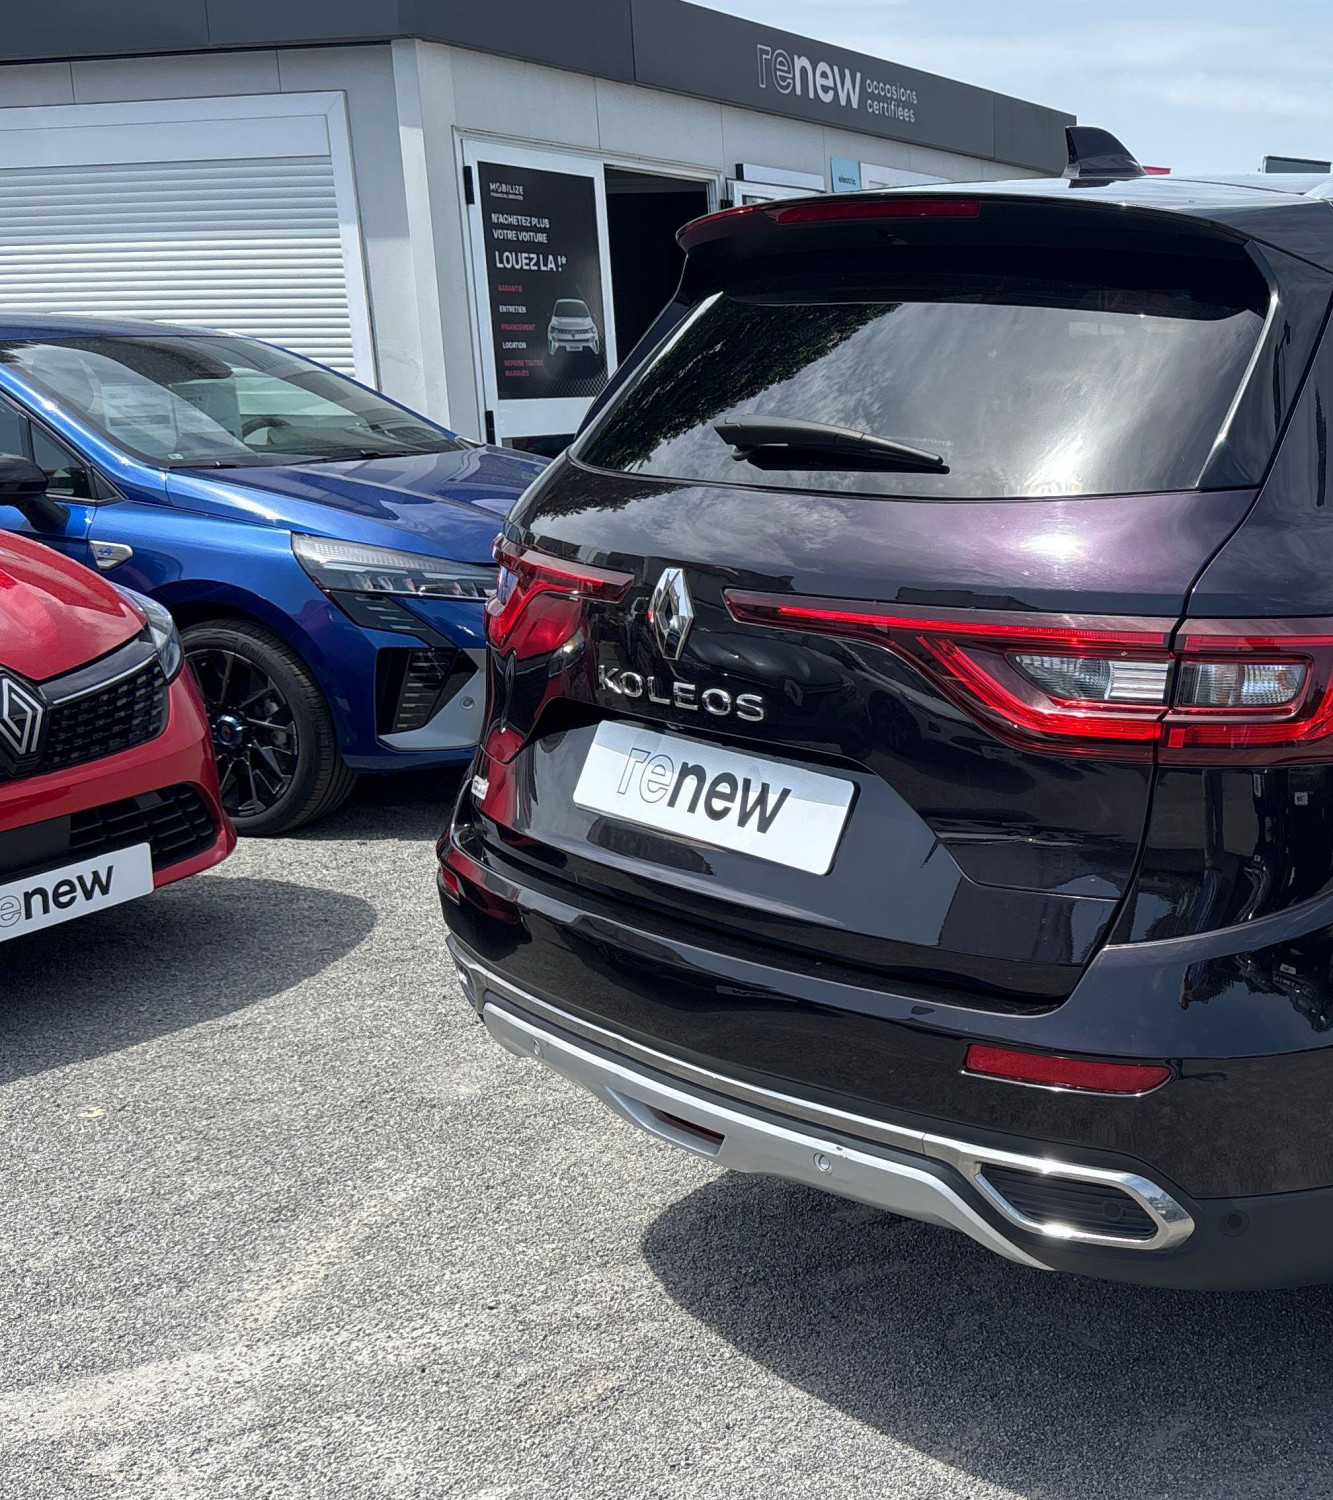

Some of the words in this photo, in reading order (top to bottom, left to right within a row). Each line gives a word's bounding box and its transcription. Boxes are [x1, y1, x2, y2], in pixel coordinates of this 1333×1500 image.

[756, 44, 861, 109] renew
[865, 78, 918, 105] occasions
[866, 97, 916, 124] certifiées
[489, 182, 524, 195] MOBILIZE
[491, 212, 531, 227] N'ACHETEZ
[531, 217, 550, 228] PLUS
[492, 228, 518, 241] VOTRE
[517, 230, 548, 244] VOITURE
[494, 250, 539, 271] LOUEZ
[539, 253, 557, 272] LA
[502, 341, 527, 349] LOCATION
[597, 664, 766, 722] KOLEOS
[616, 746, 793, 835] renew
[0, 864, 114, 928] enew
